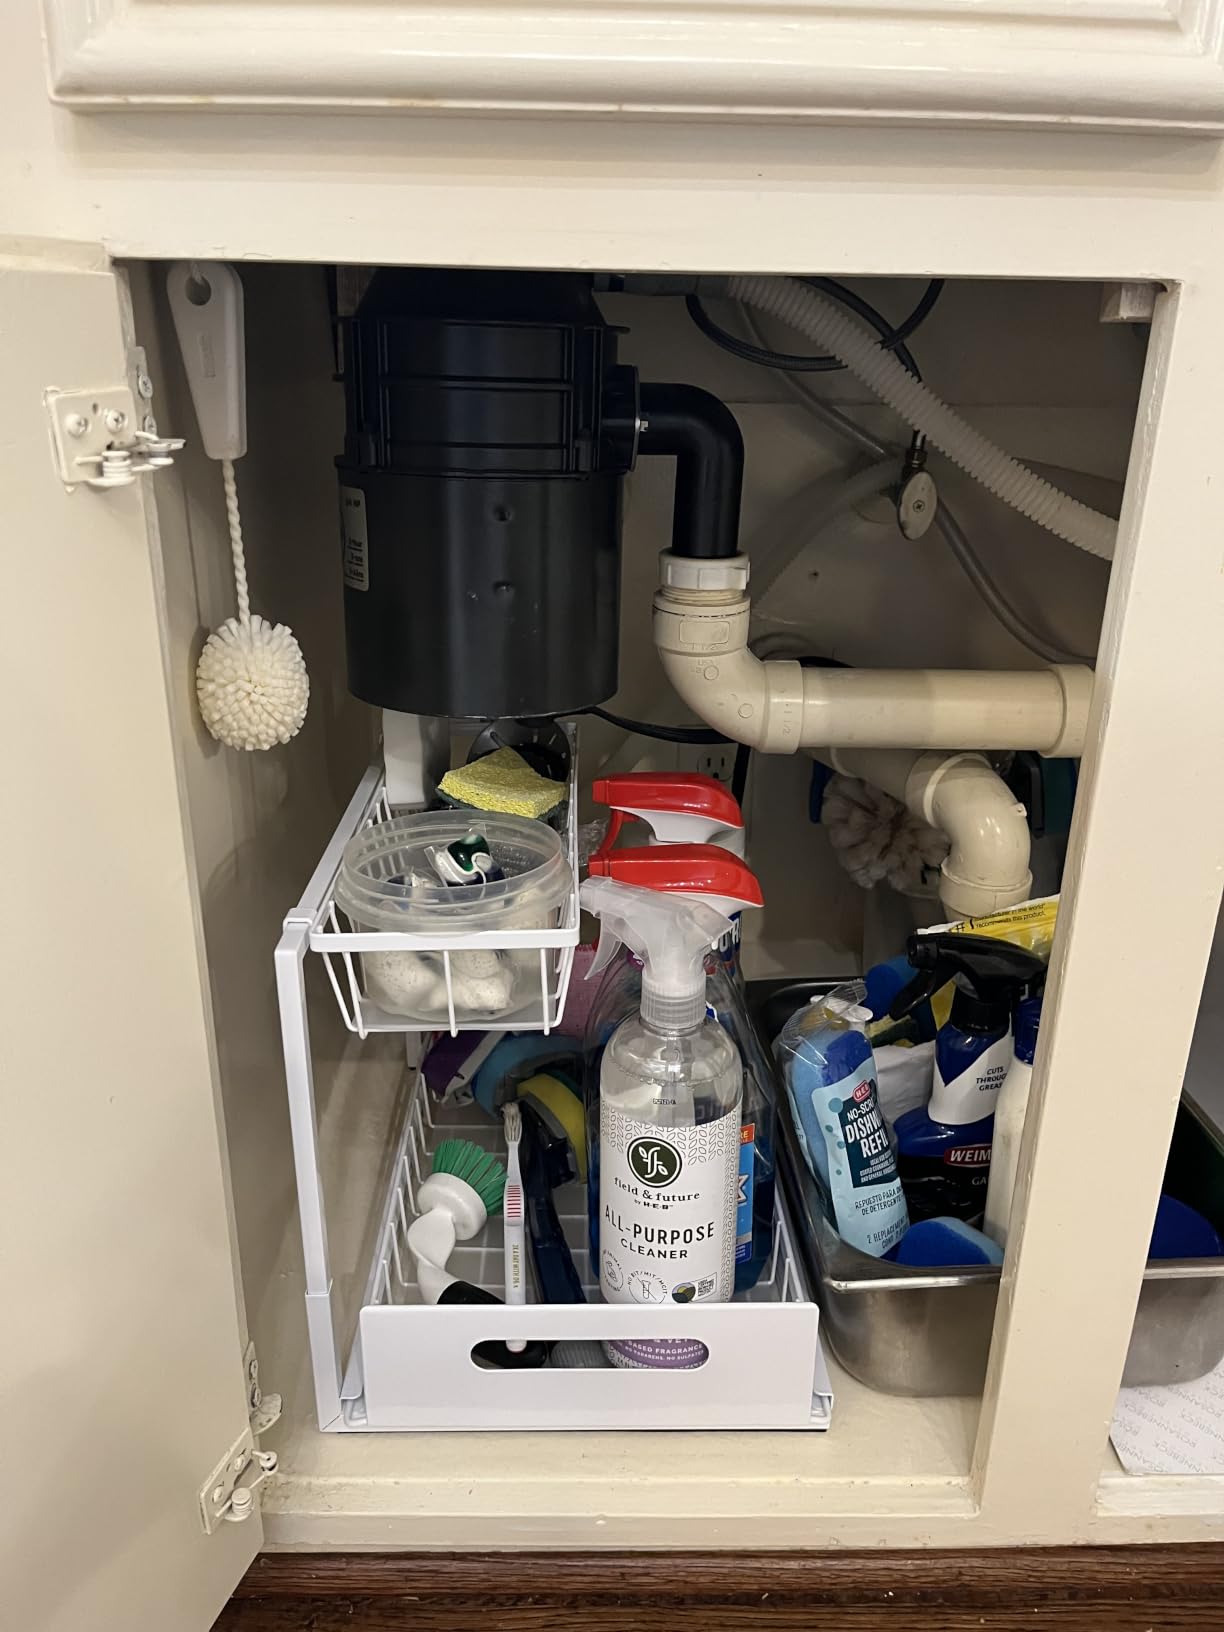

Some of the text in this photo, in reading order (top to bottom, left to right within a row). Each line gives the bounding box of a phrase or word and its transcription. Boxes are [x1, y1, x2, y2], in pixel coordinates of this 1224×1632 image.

[987, 1066, 1004, 1075] CUTS
[950, 1150, 992, 1162] WEIM
[614, 1177, 700, 1202] field & future
[855, 1193, 883, 1210] REPUESTO
[883, 1188, 896, 1200] PARA
[861, 1207, 870, 1216] DE
[605, 1204, 715, 1245] ALL-PURPOSE
[620, 1238, 689, 1259] CLEANER
[655, 1343, 703, 1355] FRAGRANCE
